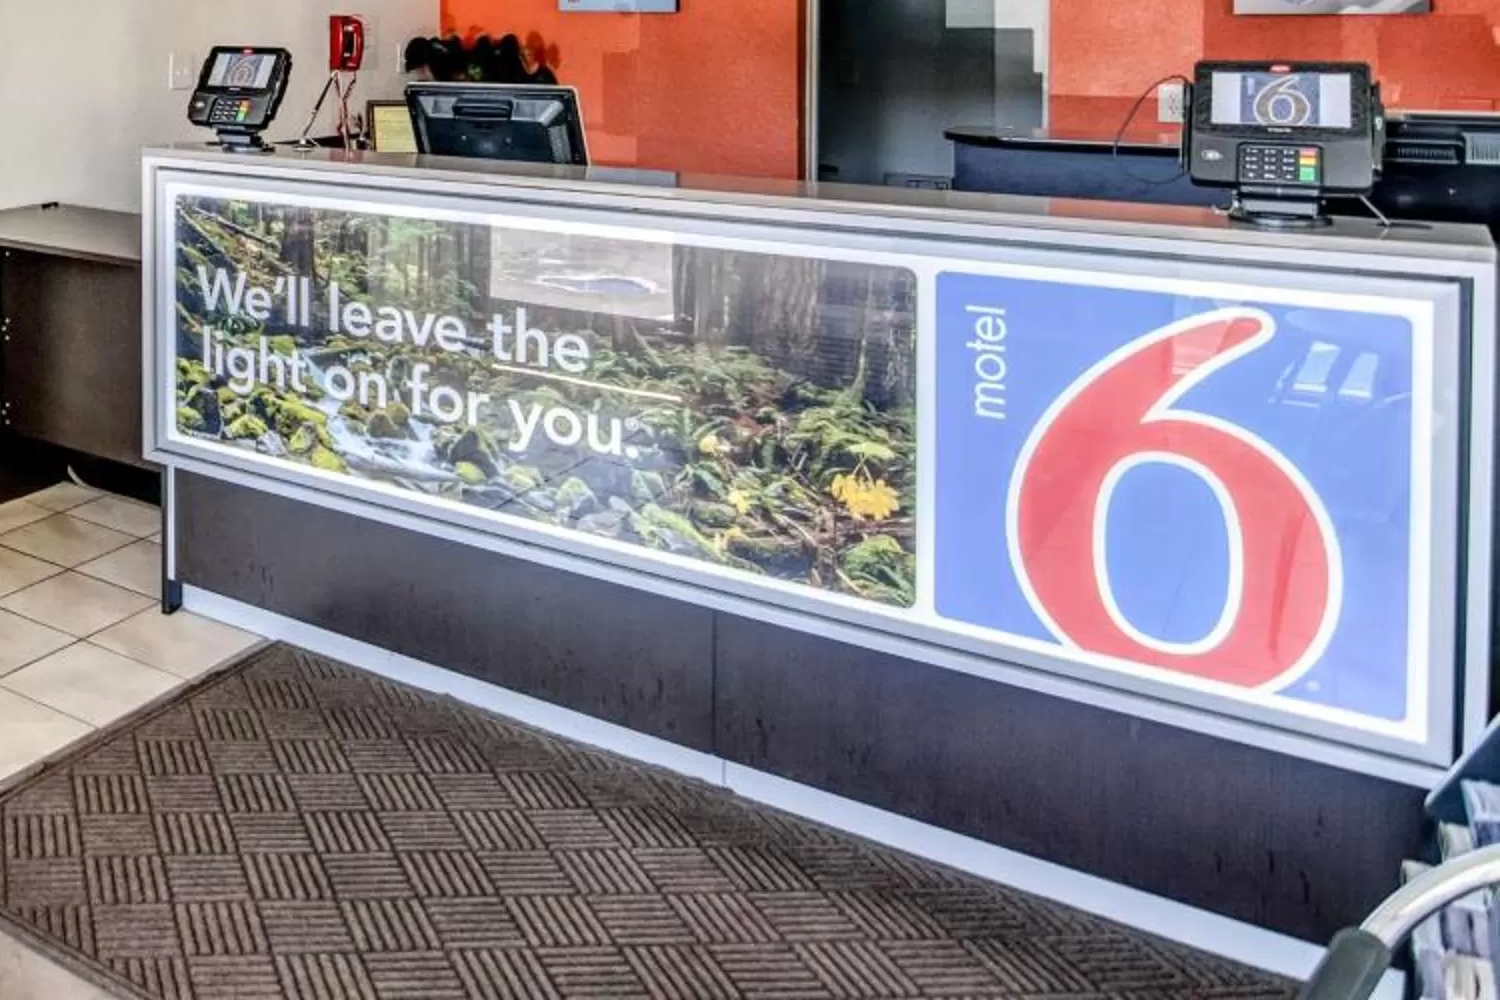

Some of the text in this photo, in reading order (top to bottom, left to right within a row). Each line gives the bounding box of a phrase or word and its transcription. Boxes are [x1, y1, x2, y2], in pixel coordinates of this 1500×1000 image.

[1252, 73, 1311, 126] 6
[198, 265, 591, 373] We'll leave the
[965, 304, 1007, 420] motel
[202, 324, 309, 396] light
[323, 364, 390, 411] on
[406, 363, 492, 427] for
[1006, 306, 1344, 697] 6
